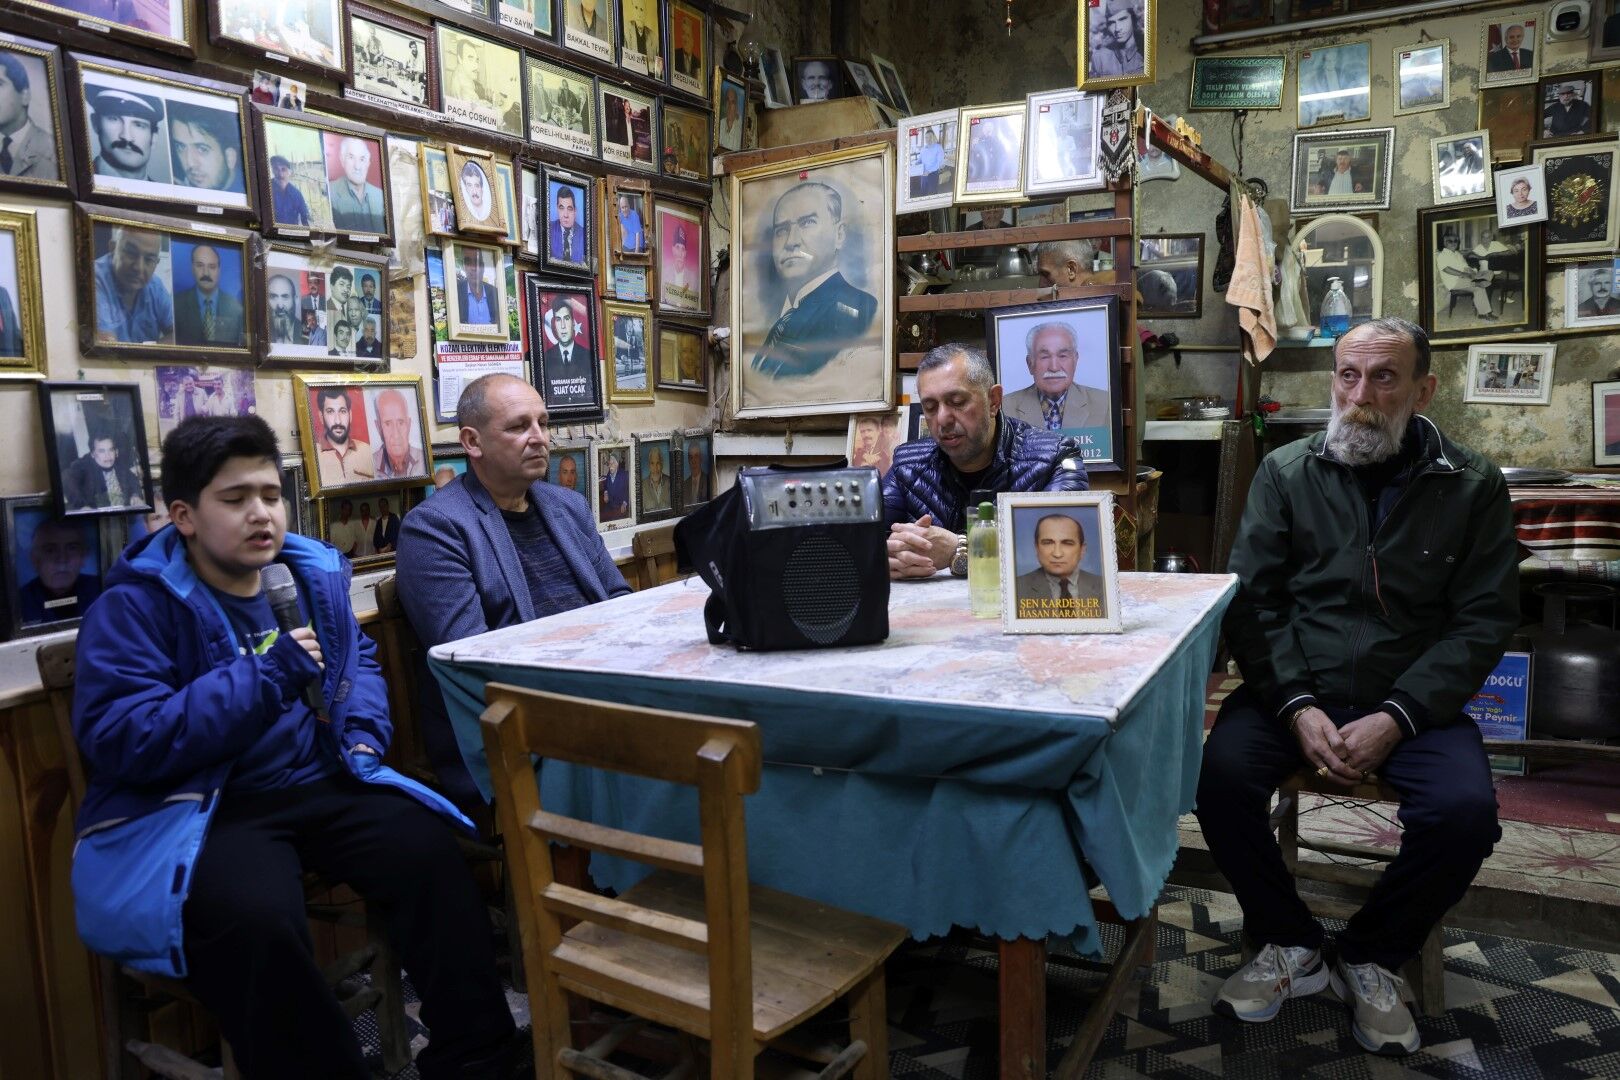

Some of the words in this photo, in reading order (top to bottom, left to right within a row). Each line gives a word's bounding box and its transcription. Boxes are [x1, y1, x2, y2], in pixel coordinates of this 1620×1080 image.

[566, 33, 591, 49] BAKKAL
[447, 104, 468, 118] PAÇA
[468, 112, 497, 127] ÇOŞKUN
[440, 344, 460, 353] KOZAN
[461, 342, 487, 353] ELEKTRİK
[553, 385, 569, 395] SUAT
[569, 384, 586, 394] OCAK
[1019, 609, 1050, 618] HASAN
[1051, 607, 1103, 618] KARAOĞLU
[1485, 712, 1518, 723] Peynir
